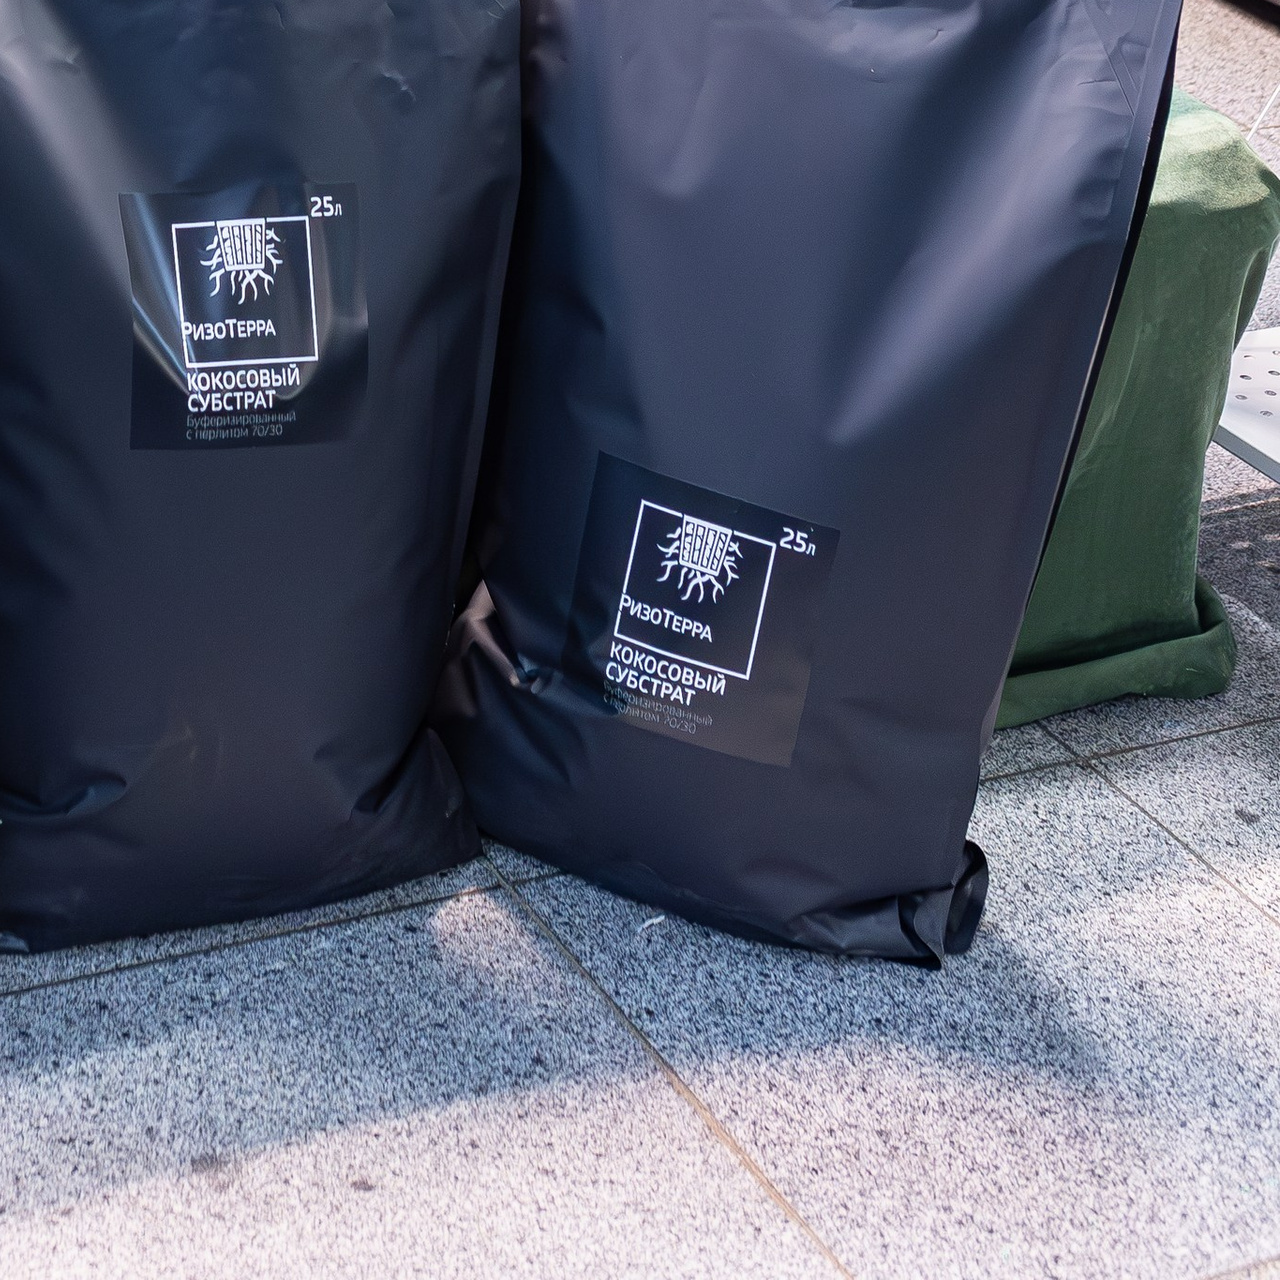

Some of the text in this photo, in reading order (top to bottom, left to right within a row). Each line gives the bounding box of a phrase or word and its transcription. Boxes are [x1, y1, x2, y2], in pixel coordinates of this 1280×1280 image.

[310, 195, 343, 218] 25л
[186, 363, 301, 391] КОКОСОВЫЙ
[187, 390, 277, 413] СУБСТРАТ
[779, 526, 817, 557] 25л
[609, 640, 727, 696] КОКОСОВЫЙ
[605, 661, 697, 706] СУБСТРАТ
